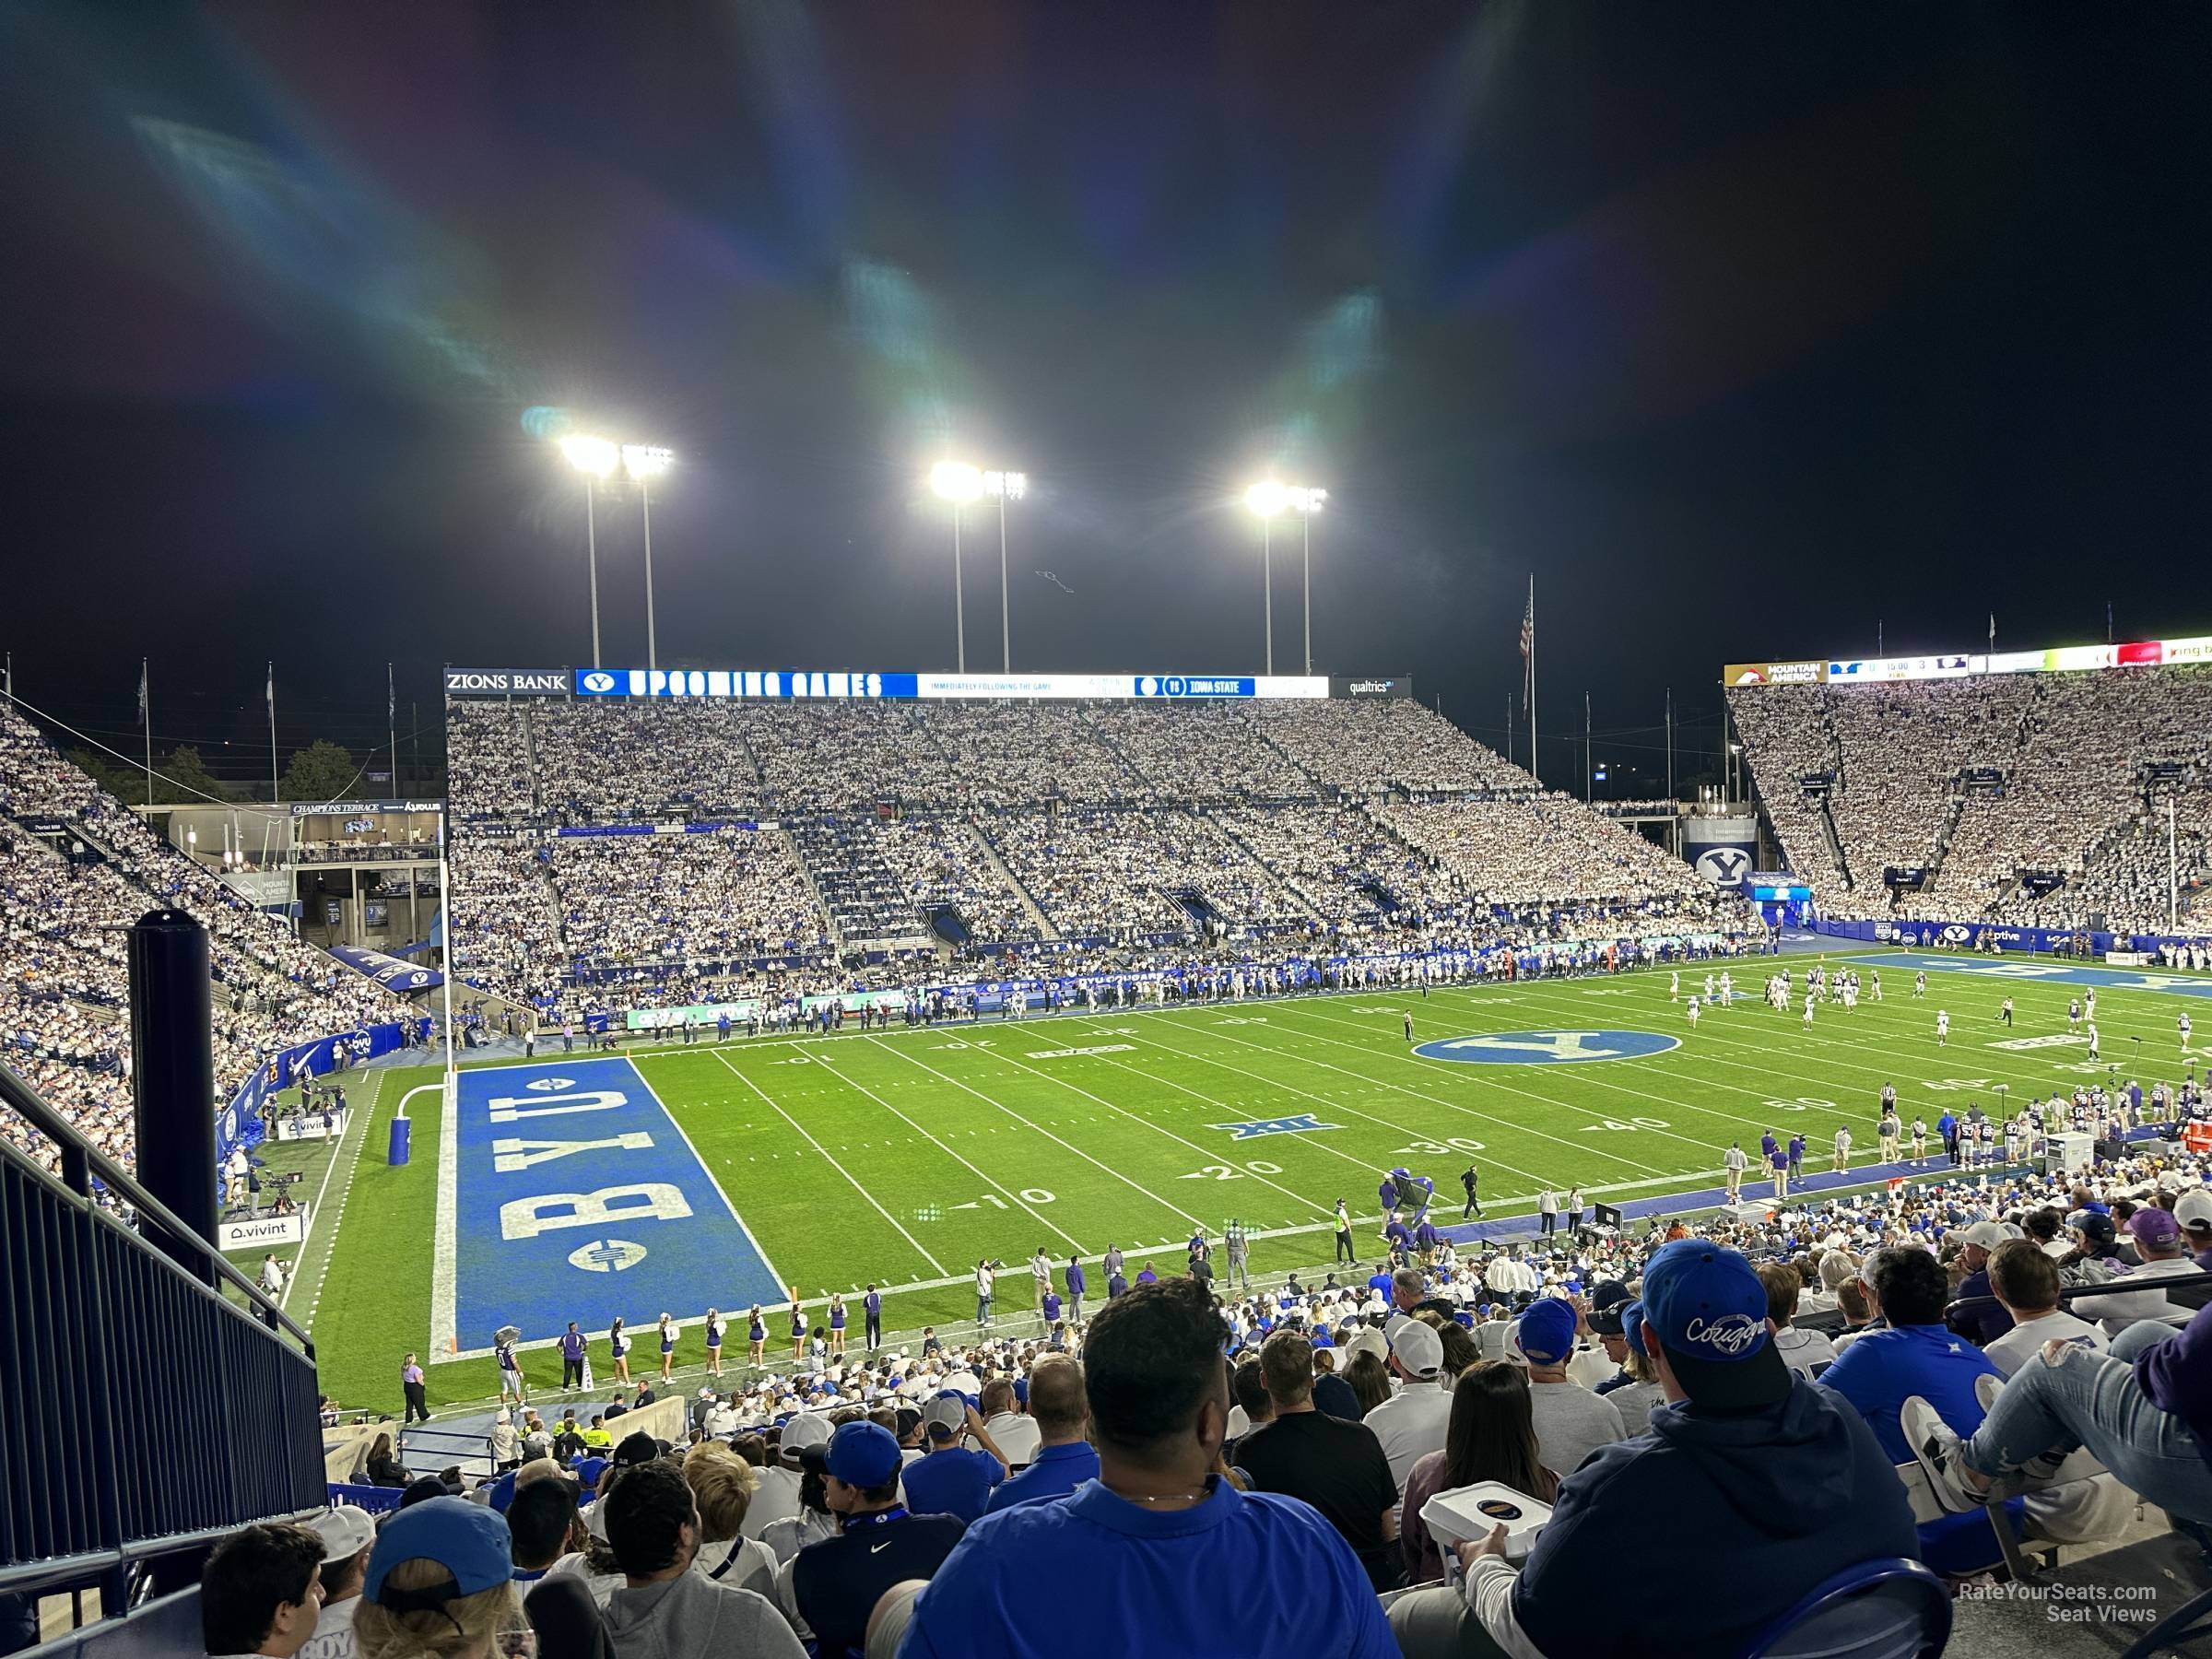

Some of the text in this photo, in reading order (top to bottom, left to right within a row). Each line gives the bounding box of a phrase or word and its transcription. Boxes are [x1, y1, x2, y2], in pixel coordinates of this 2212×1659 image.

[1768, 663, 1821, 675] MOUNTAIN
[447, 674, 568, 690] ZIONS BANK
[1771, 673, 1818, 683] AMERICA
[931, 682, 977, 691] IMMEDIATELY
[978, 682, 1018, 691] FOLLOWING
[1190, 680, 1240, 693] IOWA STATE
[1349, 680, 1387, 695] qualtrics
[293, 804, 342, 813] CHAMPIONS
[342, 804, 379, 813] TERRACE
[1994, 930, 2020, 942] ptive
[1762, 1097, 1838, 1112] 50
[300, 1121, 324, 1131] vivin
[1603, 1116, 1671, 1132] 40
[1410, 1137, 1487, 1155] 30
[488, 1091, 693, 1240] BYU
[1201, 1159, 1284, 1181] 20
[980, 1187, 1057, 1210] 10
